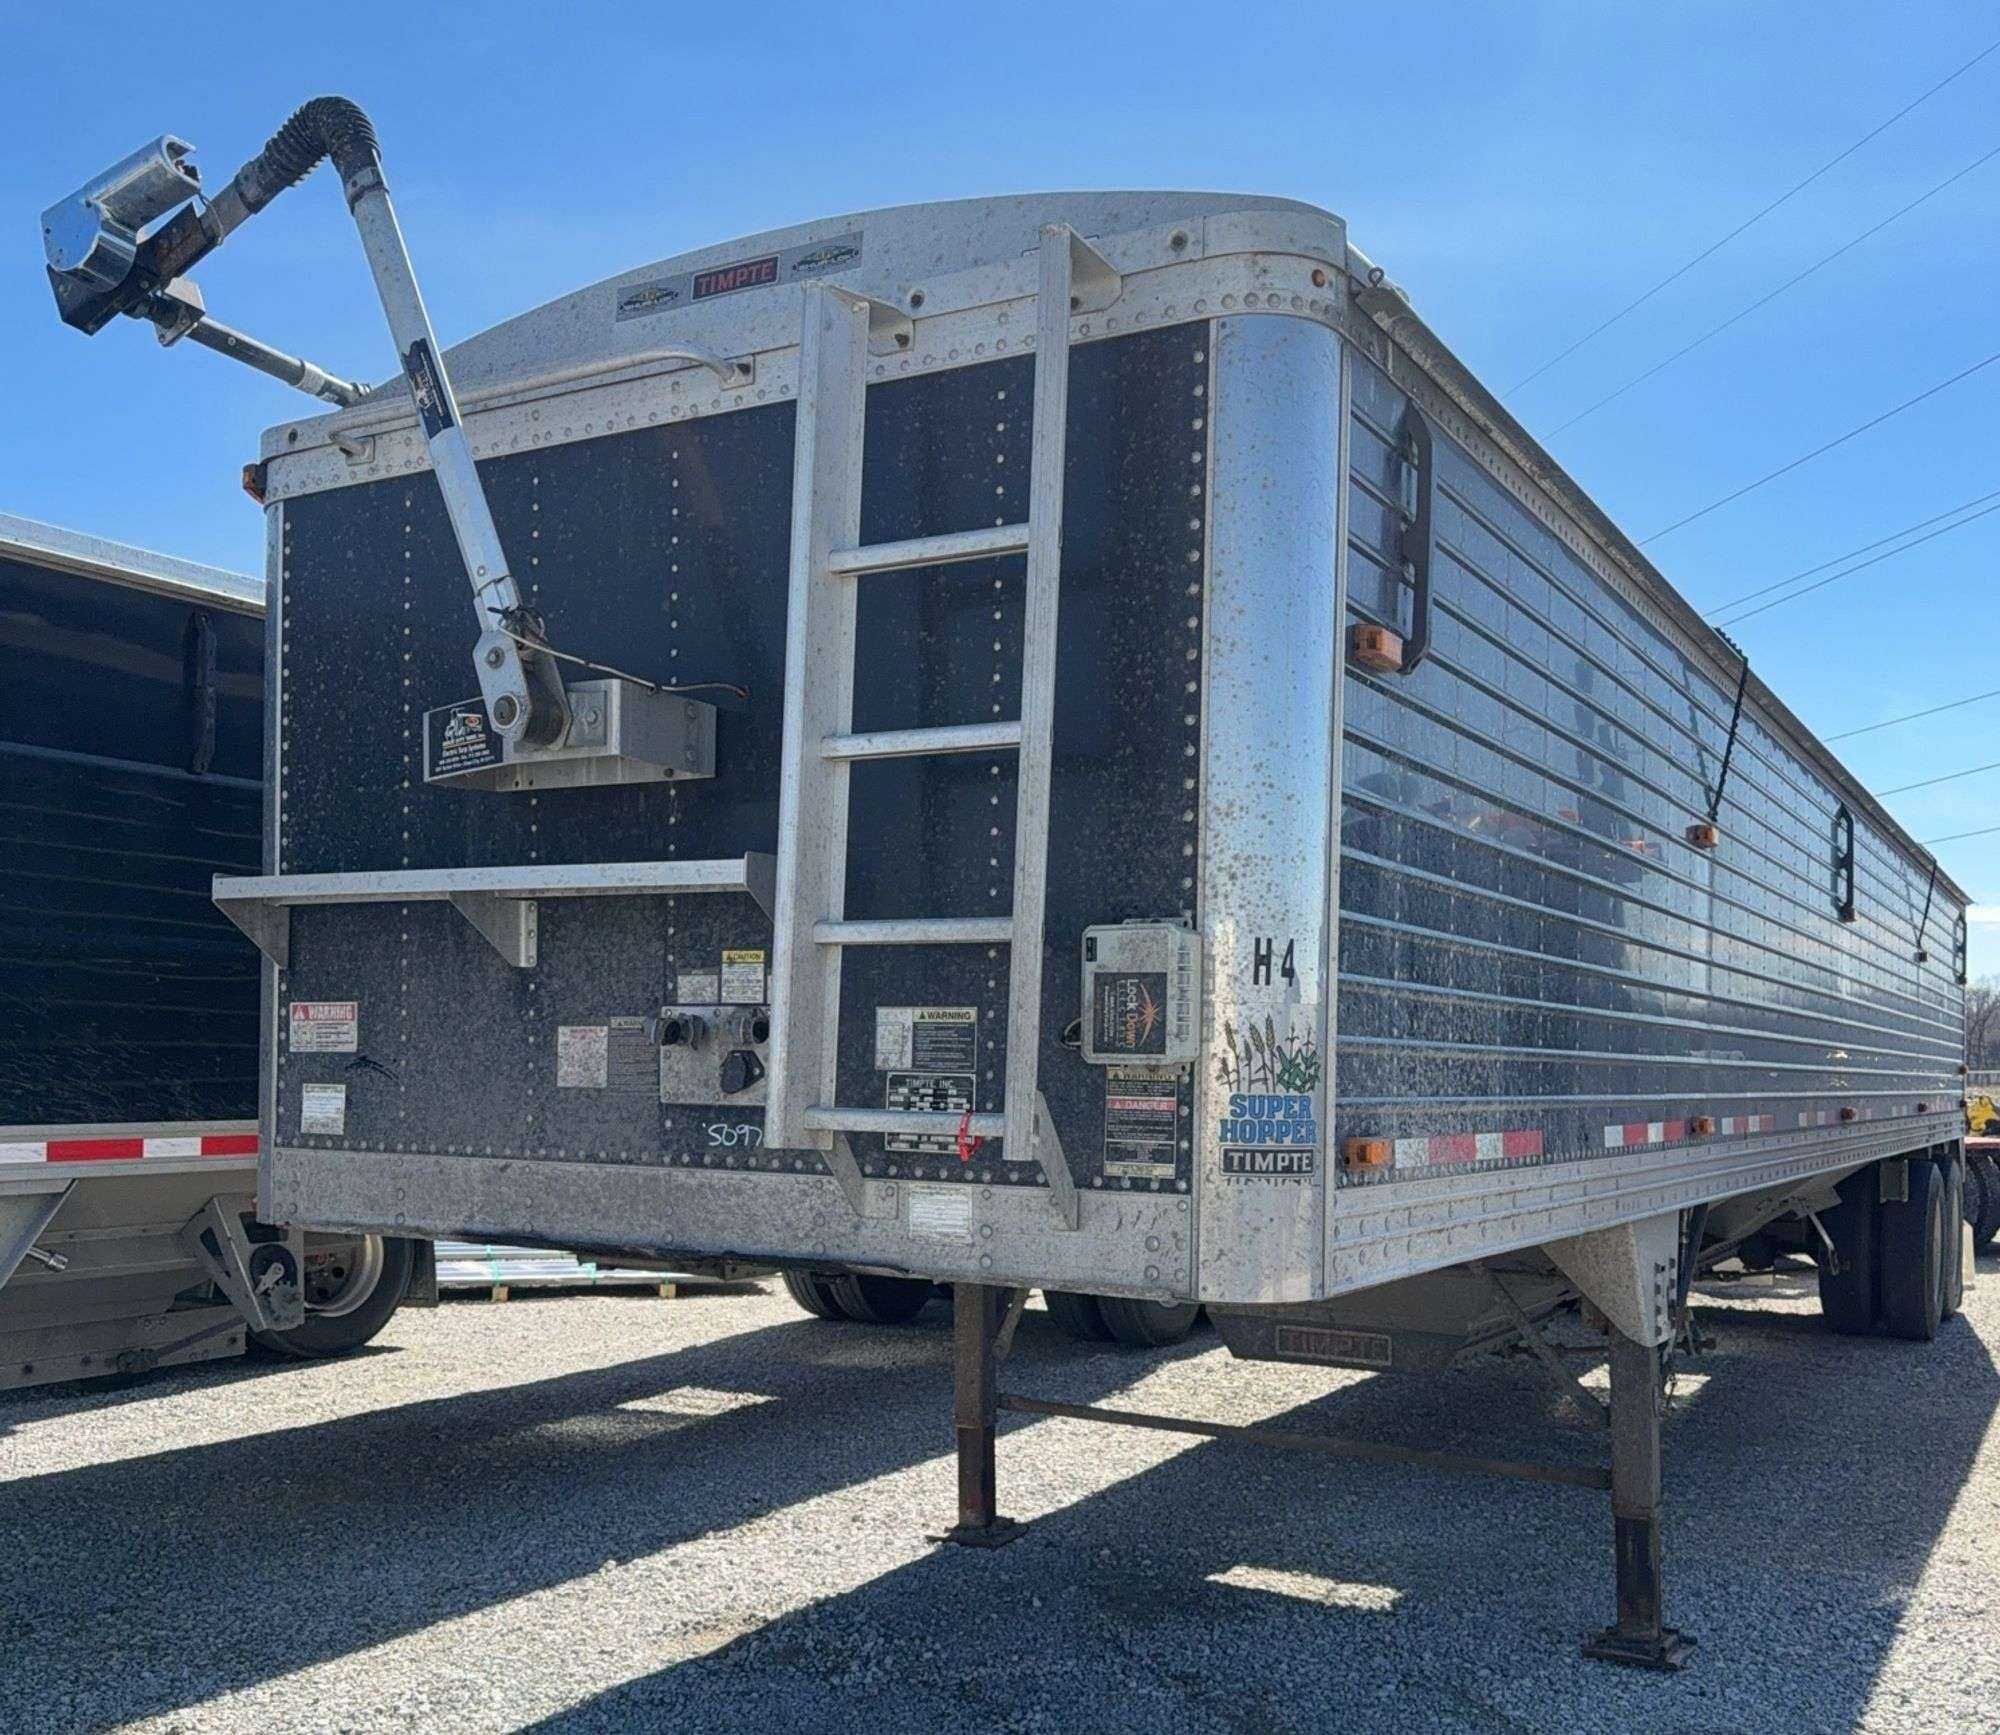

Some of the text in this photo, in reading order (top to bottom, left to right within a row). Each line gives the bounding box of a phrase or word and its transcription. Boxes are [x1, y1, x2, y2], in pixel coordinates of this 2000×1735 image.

[699, 261, 774, 296] TIMPTE
[308, 1005, 353, 1020] WARNING
[927, 1011, 971, 1020] WARNING
[1229, 1093, 1312, 1119] SUPER
[1219, 1119, 1317, 1144] HOPPER
[1227, 1152, 1312, 1172] TIMPTE
